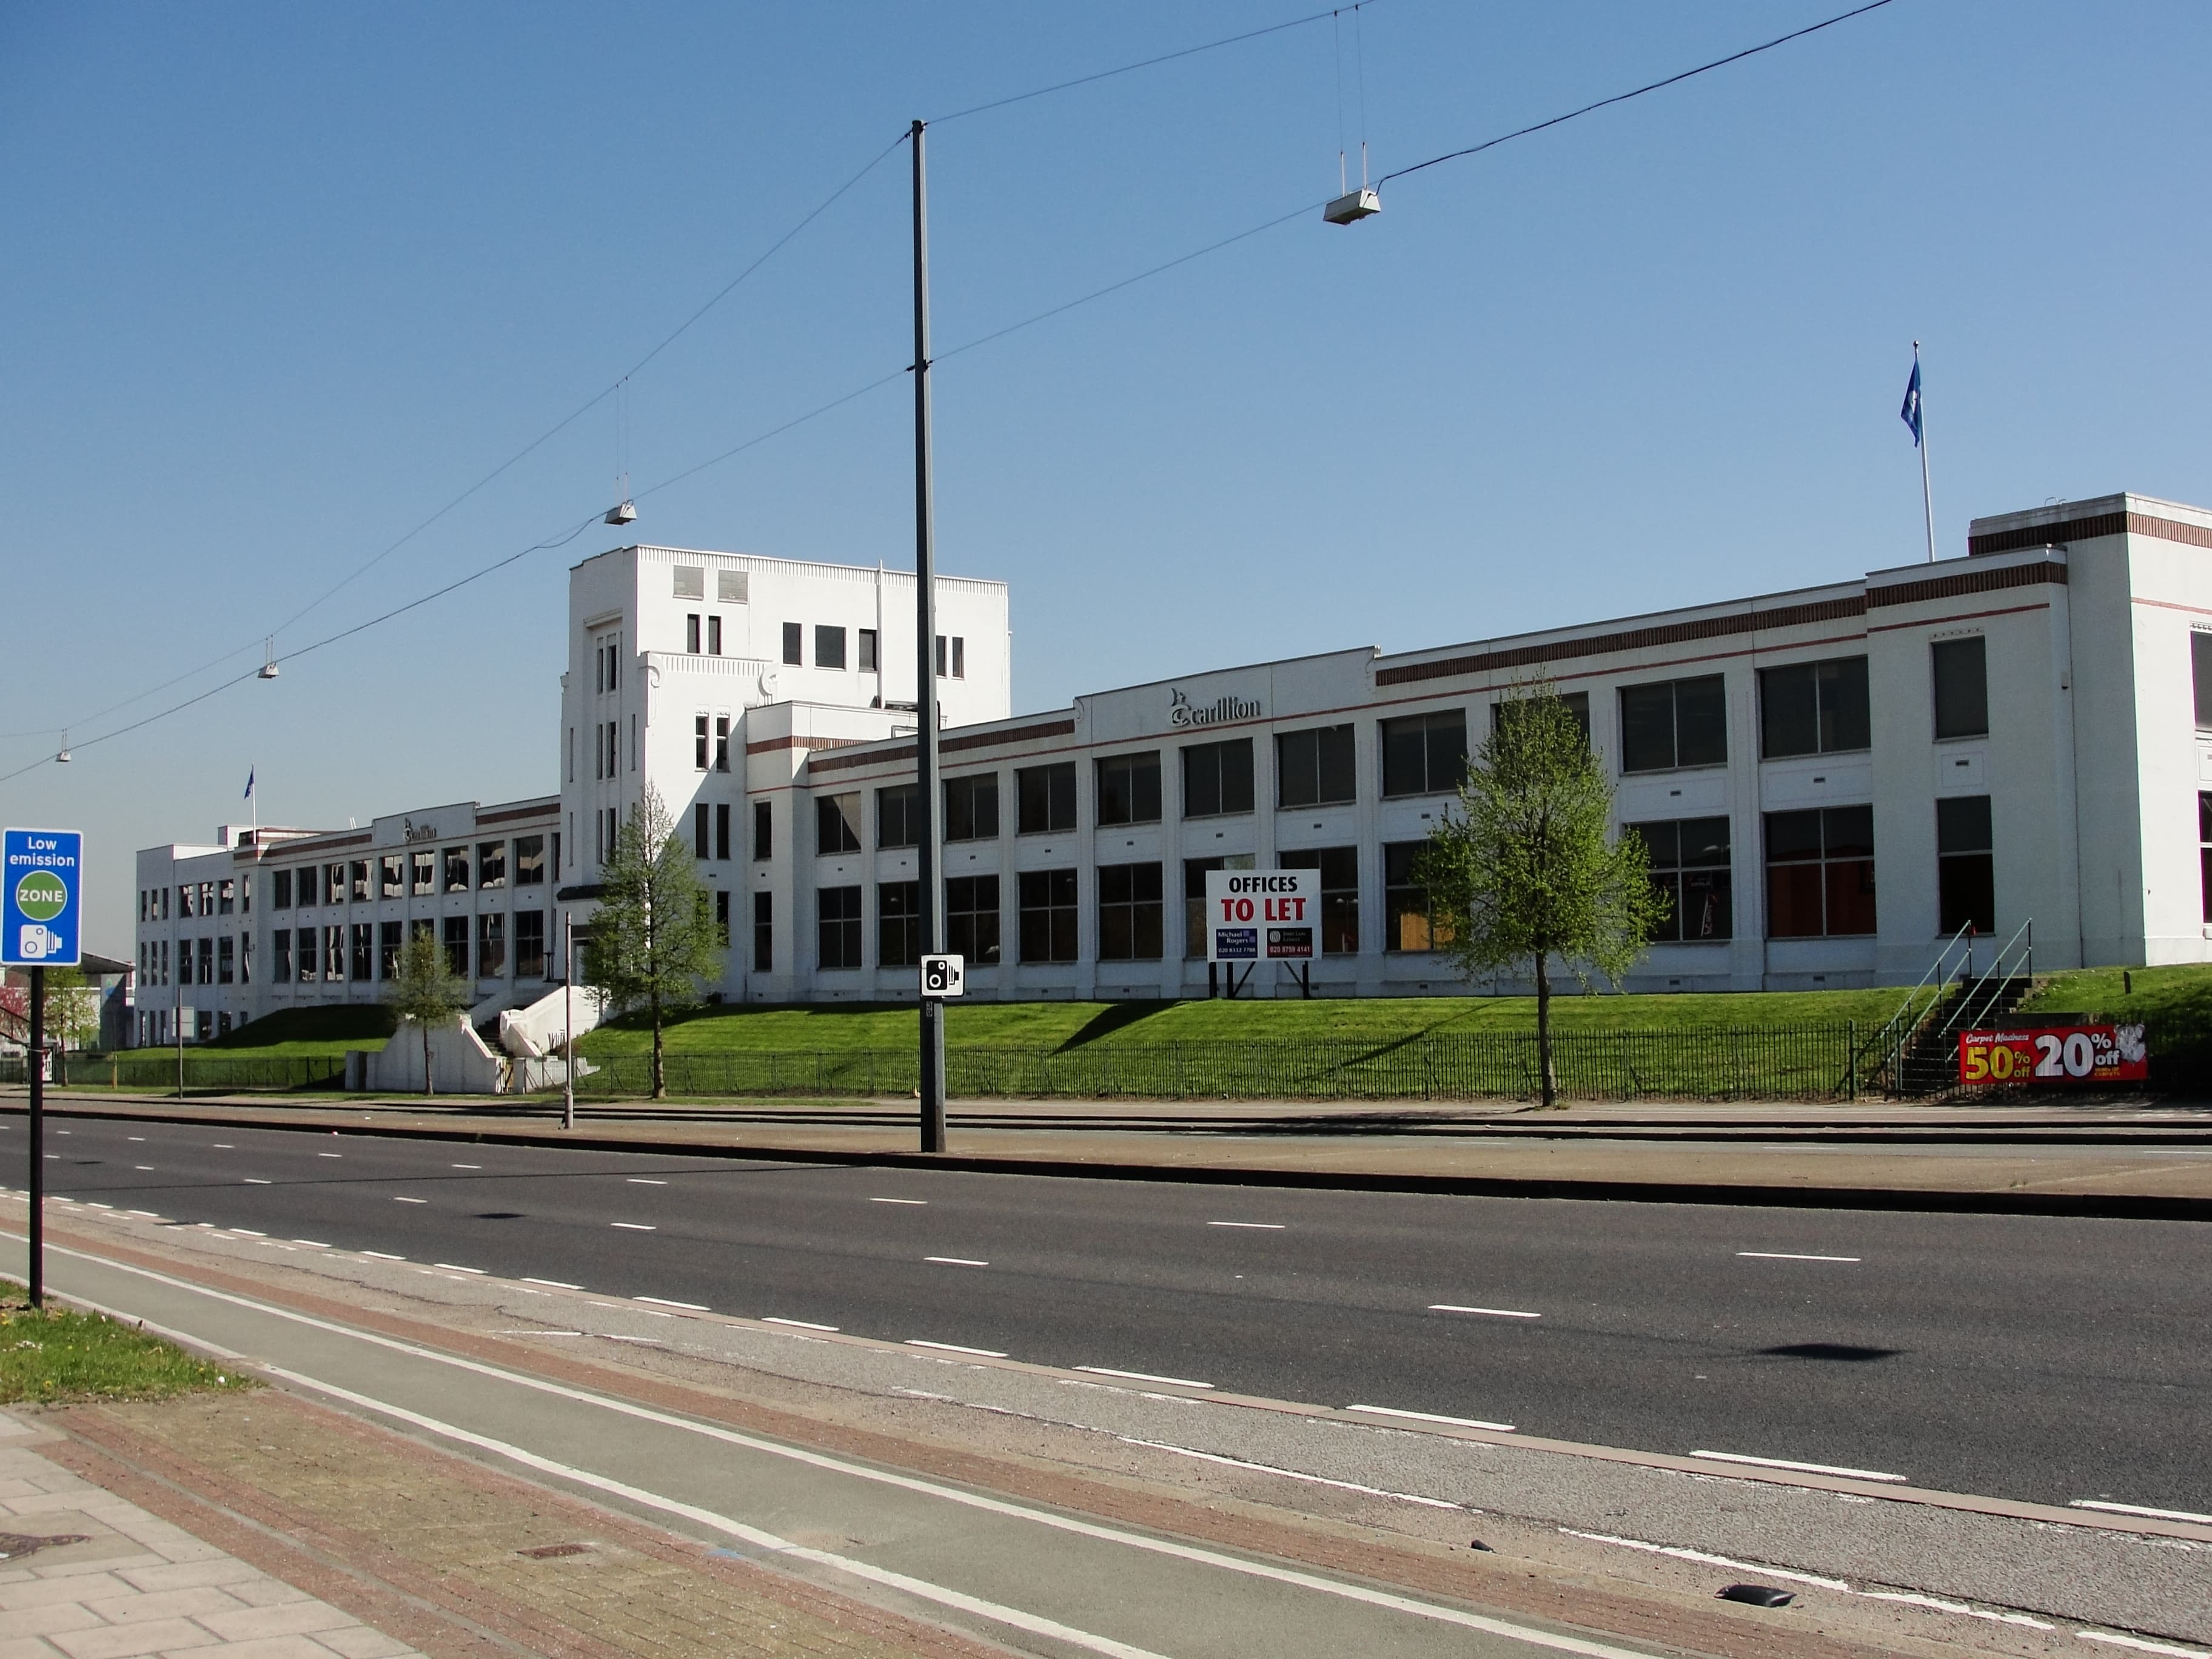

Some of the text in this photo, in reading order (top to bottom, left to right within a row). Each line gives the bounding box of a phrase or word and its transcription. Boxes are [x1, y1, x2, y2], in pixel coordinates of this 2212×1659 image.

[28, 836, 57, 850] Low
[10, 853, 75, 866] emission
[1229, 876, 1298, 893] OFFICES
[19, 890, 63, 902] ZONE
[1221, 897, 1306, 922] TO LET
[1966, 1033, 2029, 1045] Carpet Madness
[2094, 1050, 2120, 1065] off
[2014, 1066, 2031, 1078] off
